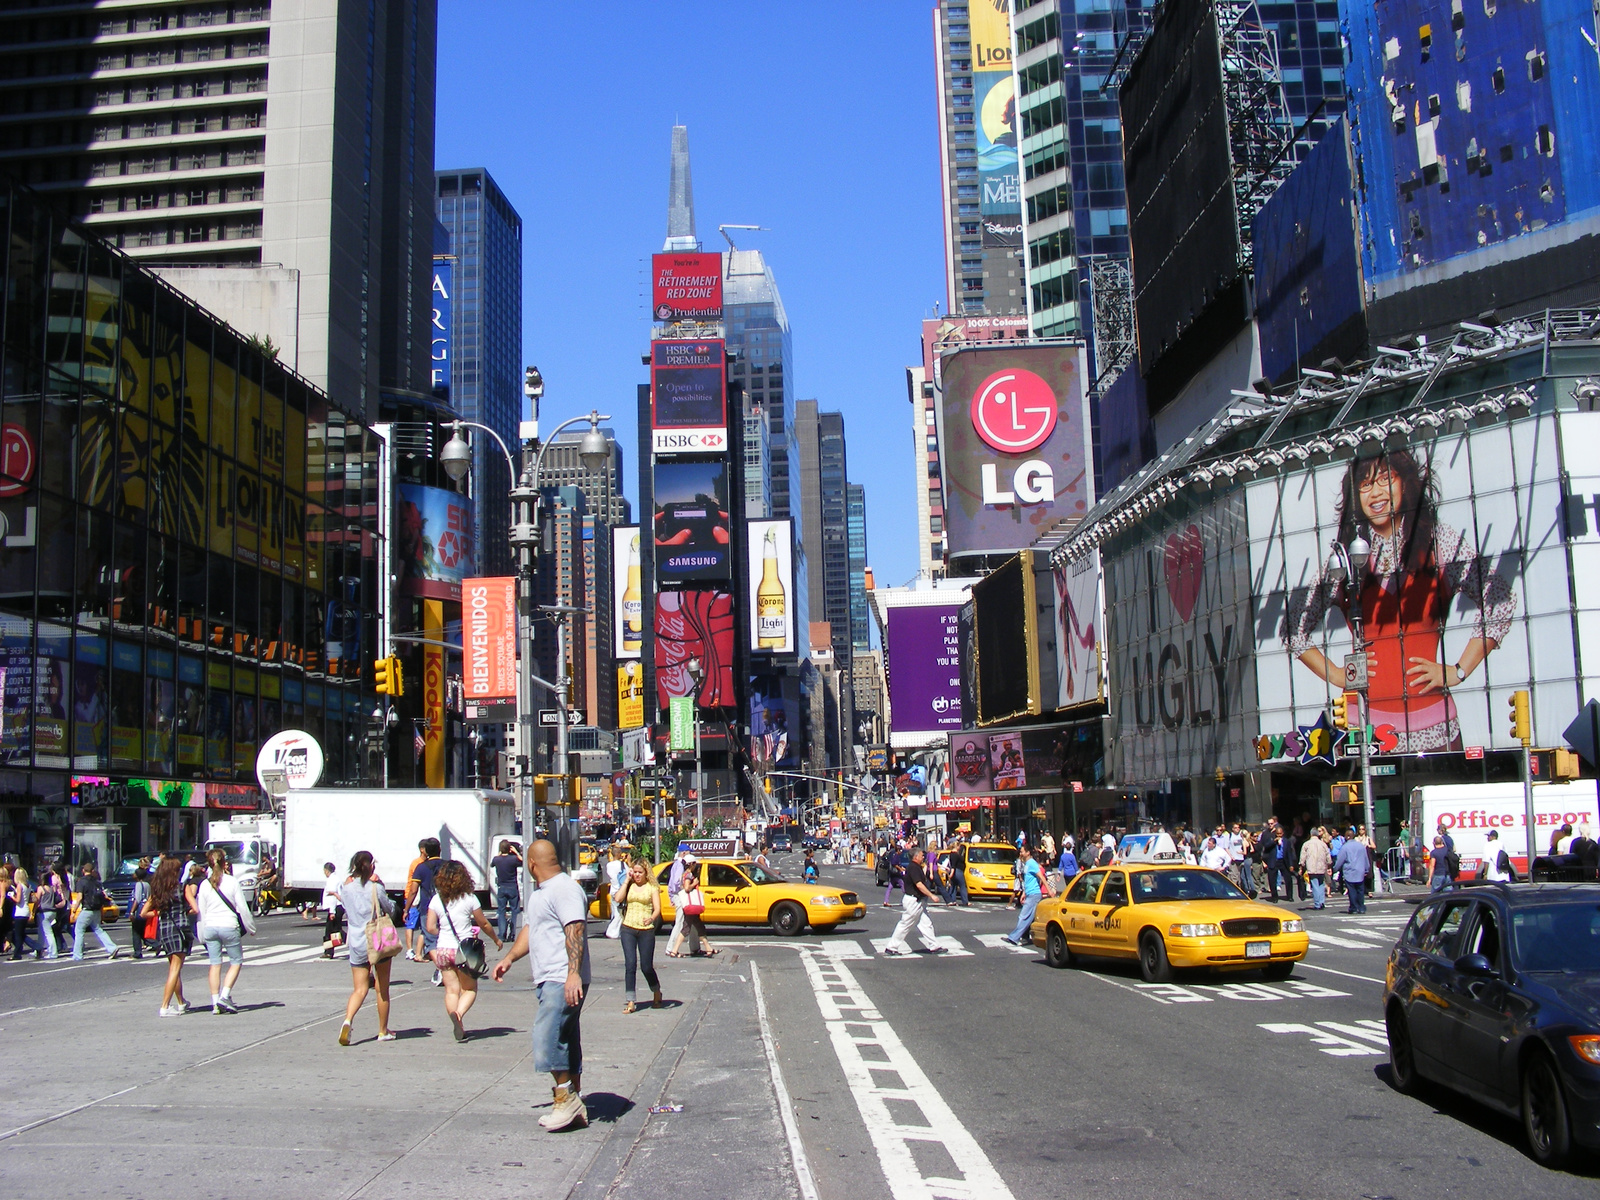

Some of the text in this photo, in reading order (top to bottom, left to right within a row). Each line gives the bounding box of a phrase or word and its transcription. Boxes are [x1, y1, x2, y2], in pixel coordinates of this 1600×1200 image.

[658, 276, 718, 287] RETIREMENT
[667, 287, 712, 298] RED ZONE
[674, 307, 721, 316] Prudential
[968, 319, 990, 327] 100%
[666, 346, 693, 354] HSBC
[667, 356, 710, 364] PREMIER
[666, 383, 692, 393] Open
[672, 394, 712, 402] possibilities
[251, 417, 283, 465] THE
[656, 434, 698, 448] HSBC
[981, 459, 1055, 506] LG
[668, 557, 717, 567] SAMSUNG
[582, 542, 595, 623] NOVOTEL
[1147, 550, 1156, 633] I
[758, 598, 784, 607] Corona
[761, 618, 784, 629] Light
[471, 586, 489, 694] BIENVENIDOS
[506, 630, 514, 640] OF
[497, 636, 505, 663] SQUARE
[655, 613, 698, 699] Coca-Cola
[507, 641, 515, 692] CROSSROADS
[1131, 624, 1232, 736] UGLY
[424, 652, 443, 742] Kodak
[286, 755, 307, 765] FOX
[936, 797, 972, 809] swatch
[1437, 810, 1514, 829] Office
[687, 843, 729, 851] MULBERRY
